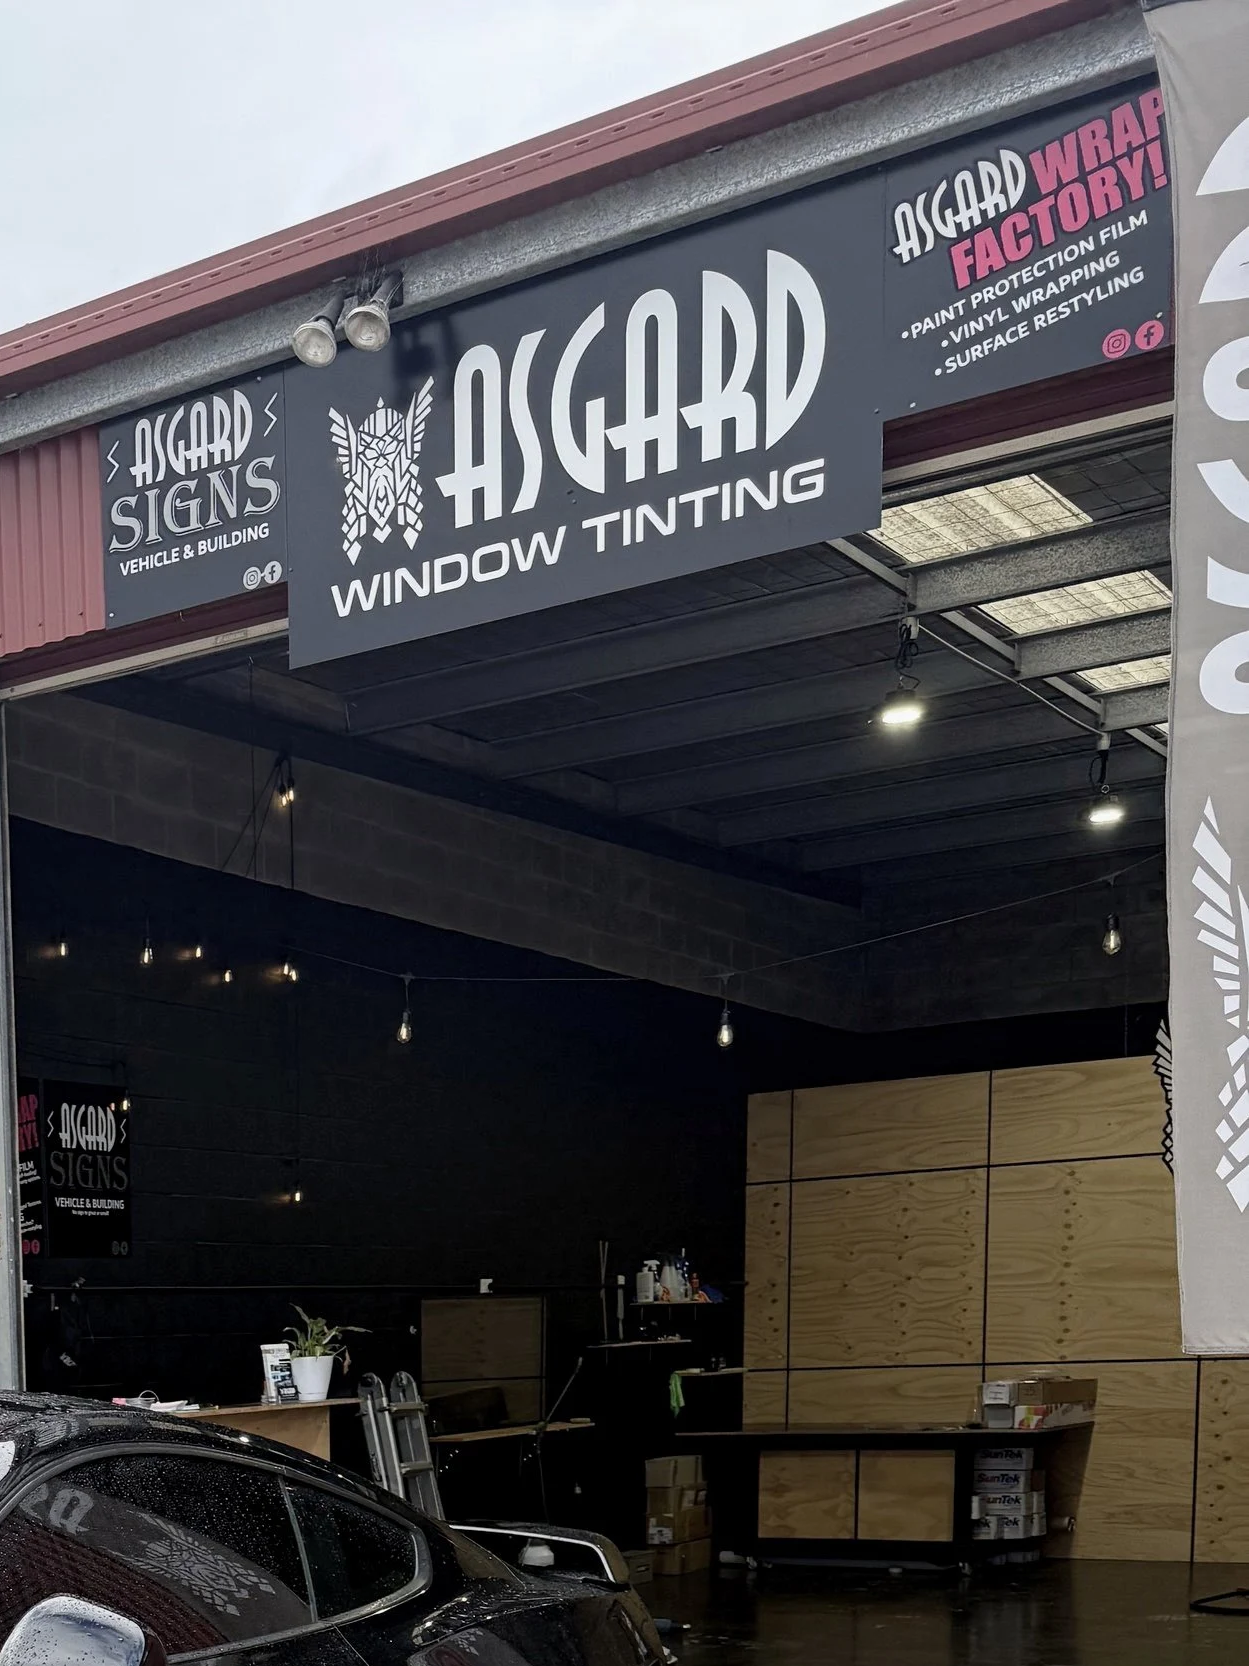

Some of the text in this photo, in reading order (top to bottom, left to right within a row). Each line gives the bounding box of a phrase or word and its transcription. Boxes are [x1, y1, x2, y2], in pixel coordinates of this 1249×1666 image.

[893, 88, 1166, 264] ASGARD WRAP
[950, 140, 1168, 291] FACTORY!
[910, 209, 1149, 340] PAINT PROTECTION FILM
[945, 266, 1146, 375] SURFACE RESTYLING
[950, 250, 1121, 345] VINYL WRAPPING
[129, 389, 253, 488] ASGARD
[435, 249, 827, 529] ASGARD
[109, 454, 281, 554] SIGNS
[119, 522, 270, 577] VEHICLE & BUILDING
[331, 458, 825, 617] WINDOW TINTING
[49, 1150, 128, 1191] SIGNS
[58, 1102, 117, 1152] ASGARD
[55, 1197, 85, 1209] VEHICLE
[92, 1198, 125, 1210] BUILDING
[978, 1473, 1021, 1484] SunTek
